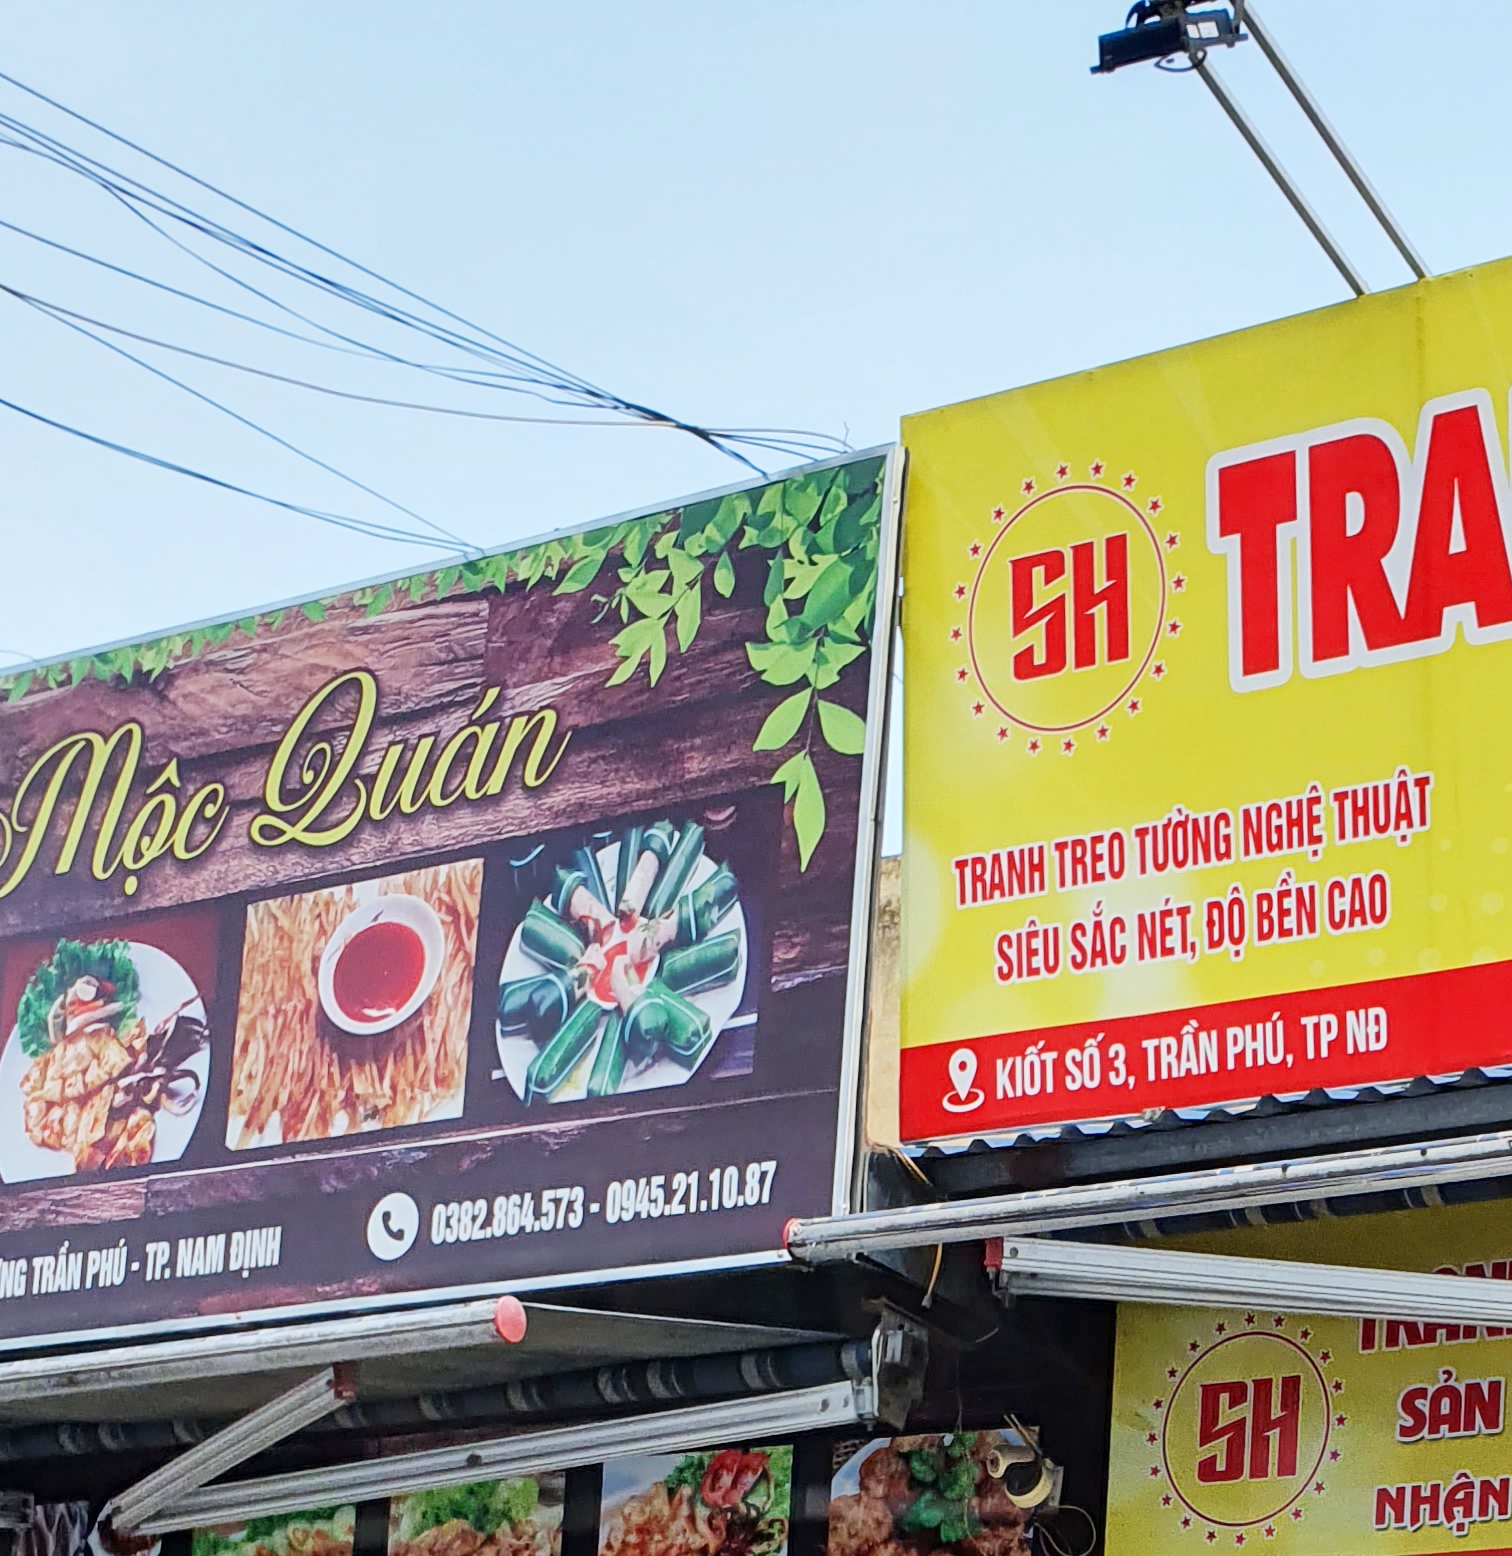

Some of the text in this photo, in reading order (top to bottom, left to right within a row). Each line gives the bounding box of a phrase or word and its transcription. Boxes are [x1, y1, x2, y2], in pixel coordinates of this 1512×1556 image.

[1009, 533, 1131, 682] SH
[0, 670, 572, 896] Mộc Quán
[955, 767, 1432, 906] TRANH TREO TƯỜNG NGHỆ THUẬT
[996, 870, 1389, 982] SIÊU SẮC NÉT, ĐỘ BỀN CAO
[995, 1008, 1389, 1100] KIỐT SỐ 3, TRẦN PHÚ, TP NĐ
[431, 1188, 585, 1246] 0382.864.573
[606, 1160, 777, 1225] 0945.21.10.87
[0, 1258, 28, 1299] NG
[85, 1238, 128, 1290] PHÚ
[146, 1241, 171, 1281] TP.
[176, 1234, 226, 1278] NAM
[229, 1226, 282, 1279] ĐỊNH
[1197, 1375, 1300, 1482] SH
[1400, 1370, 1500, 1440] SẢN
[1374, 1471, 1510, 1536] NHẬN
